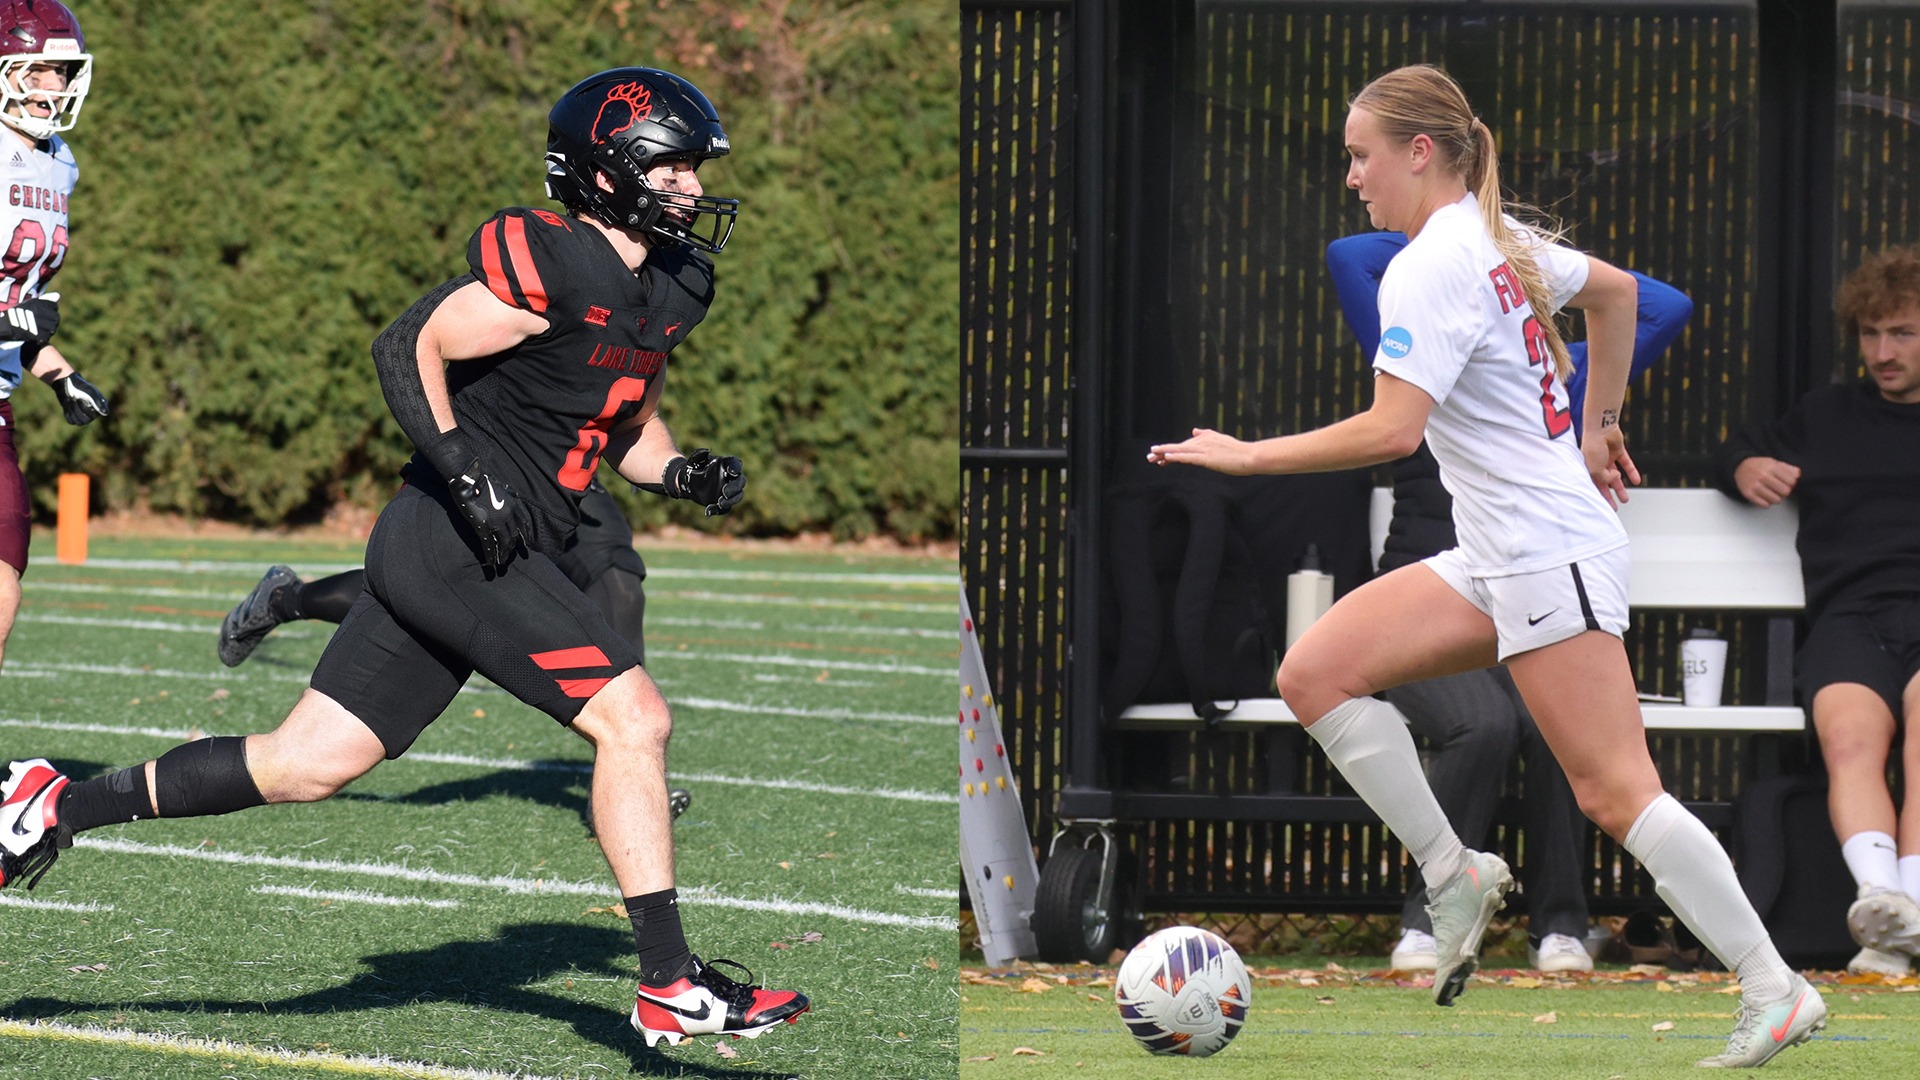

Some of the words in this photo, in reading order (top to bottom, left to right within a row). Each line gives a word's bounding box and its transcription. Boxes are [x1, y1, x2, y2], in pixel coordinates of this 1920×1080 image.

[587, 343, 630, 370] LAKE
[628, 348, 668, 375] FOREST
[1382, 337, 1409, 354] NCAA
[557, 376, 646, 492] 6
